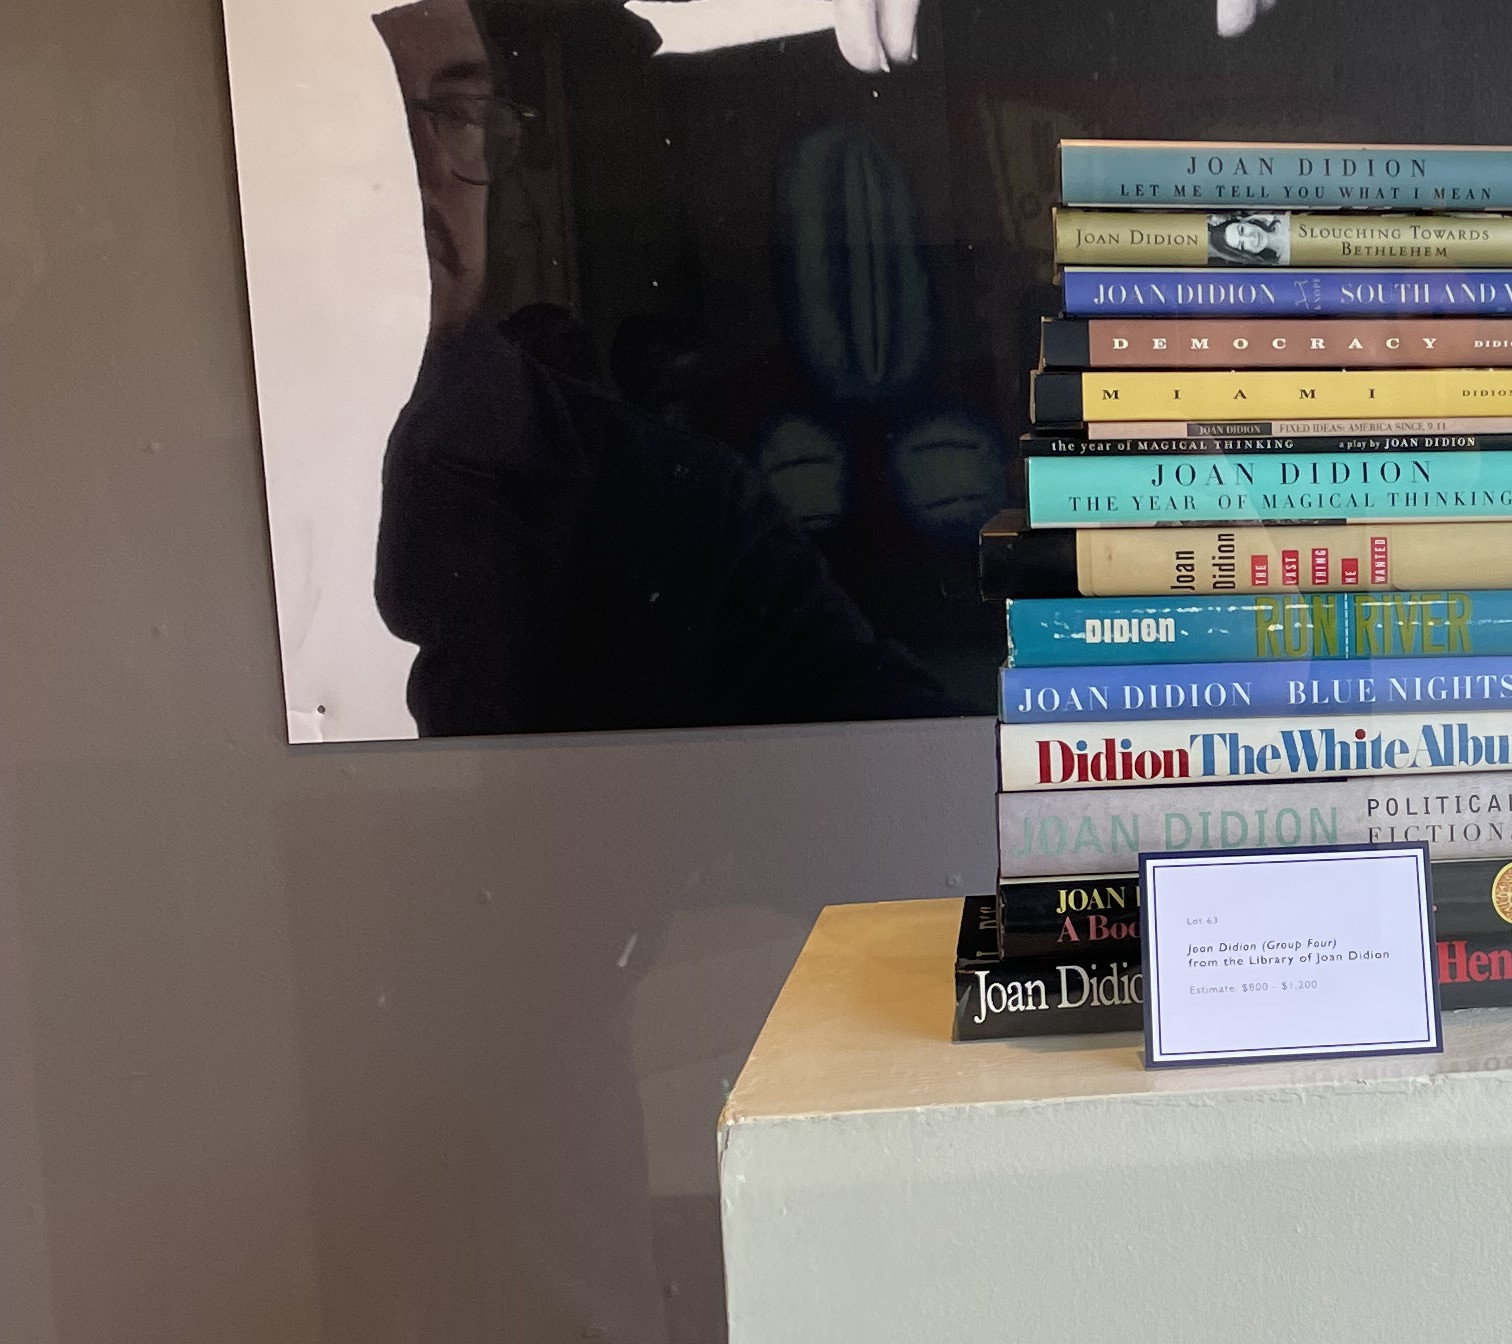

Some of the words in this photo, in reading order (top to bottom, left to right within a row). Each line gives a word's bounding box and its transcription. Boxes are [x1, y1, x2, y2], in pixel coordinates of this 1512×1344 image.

[1187, 156, 1274, 176] JOAN
[1299, 158, 1427, 178] DIDION
[1120, 184, 1160, 197] LET
[1174, 184, 1202, 197] ME
[1215, 185, 1270, 198] TELL
[1283, 186, 1325, 199] YOU
[1339, 186, 1400, 199] WHAT
[1414, 187, 1420, 199] I
[1434, 187, 1492, 200] MEAN
[1093, 283, 1166, 304] JOAN
[1178, 283, 1276, 304] DIDION
[1340, 282, 1429, 304] SOUTH
[1439, 282, 1496, 304] AND
[1112, 337, 1438, 350] DEMOCRACY
[1102, 388, 1376, 400] MIAMI
[1199, 425, 1225, 435] JOAN
[1226, 424, 1262, 435] DIDION
[1279, 423, 1311, 434] FIXED
[1349, 422, 1393, 433] AMERICA
[1051, 441, 1076, 452] the
[1080, 442, 1112, 455] year
[1117, 440, 1133, 451] of
[1138, 440, 1208, 451] MAGICAL
[1214, 439, 1295, 450] THINKING
[1347, 438, 1367, 450] play
[1370, 439, 1381, 450] by
[1384, 437, 1419, 450] JOAN
[1424, 437, 1477, 448] DIDION
[1151, 462, 1256, 487] JOAN
[1280, 460, 1432, 485] DIDION
[1068, 496, 1119, 512] THE
[1132, 495, 1198, 511] YEAR
[1218, 494, 1248, 510] OF
[1262, 492, 1376, 509] MAGICAL
[1171, 550, 1196, 591] Joan
[1212, 533, 1236, 590] Didion
[1255, 564, 1267, 585] THE
[1285, 556, 1297, 585] LAST
[1315, 549, 1327, 584] THING
[1345, 570, 1357, 584] HE
[1374, 539, 1386, 584] WANTED
[1085, 617, 1176, 644] DIDION
[1254, 594, 1338, 657] RUN
[1354, 592, 1474, 656] RIVER
[1018, 685, 1110, 713] JOAN
[1122, 682, 1253, 710] DIDION
[1287, 677, 1377, 705] BLUE
[1012, 813, 1140, 858] JOAN
[1164, 806, 1338, 851] DIDION
[1055, 886, 1126, 914] JOAN
[1056, 916, 1081, 944] A
[1088, 914, 1141, 942] Boo
[1186, 917, 1203, 926] Lot
[1206, 916, 1219, 925] 63
[1187, 943, 1214, 956] Joan
[1219, 941, 1257, 953] Didion
[1262, 940, 1302, 953] (Group
[1307, 937, 1337, 949] Four)
[1188, 958, 1219, 968] from
[1223, 956, 1244, 966] the
[1249, 955, 1294, 967] Library
[1299, 953, 1313, 963] of
[1316, 952, 1343, 965] Joan
[1348, 950, 1390, 961] Didion
[973, 970, 1050, 1024] Joan
[1056, 961, 1144, 1009] Didio
